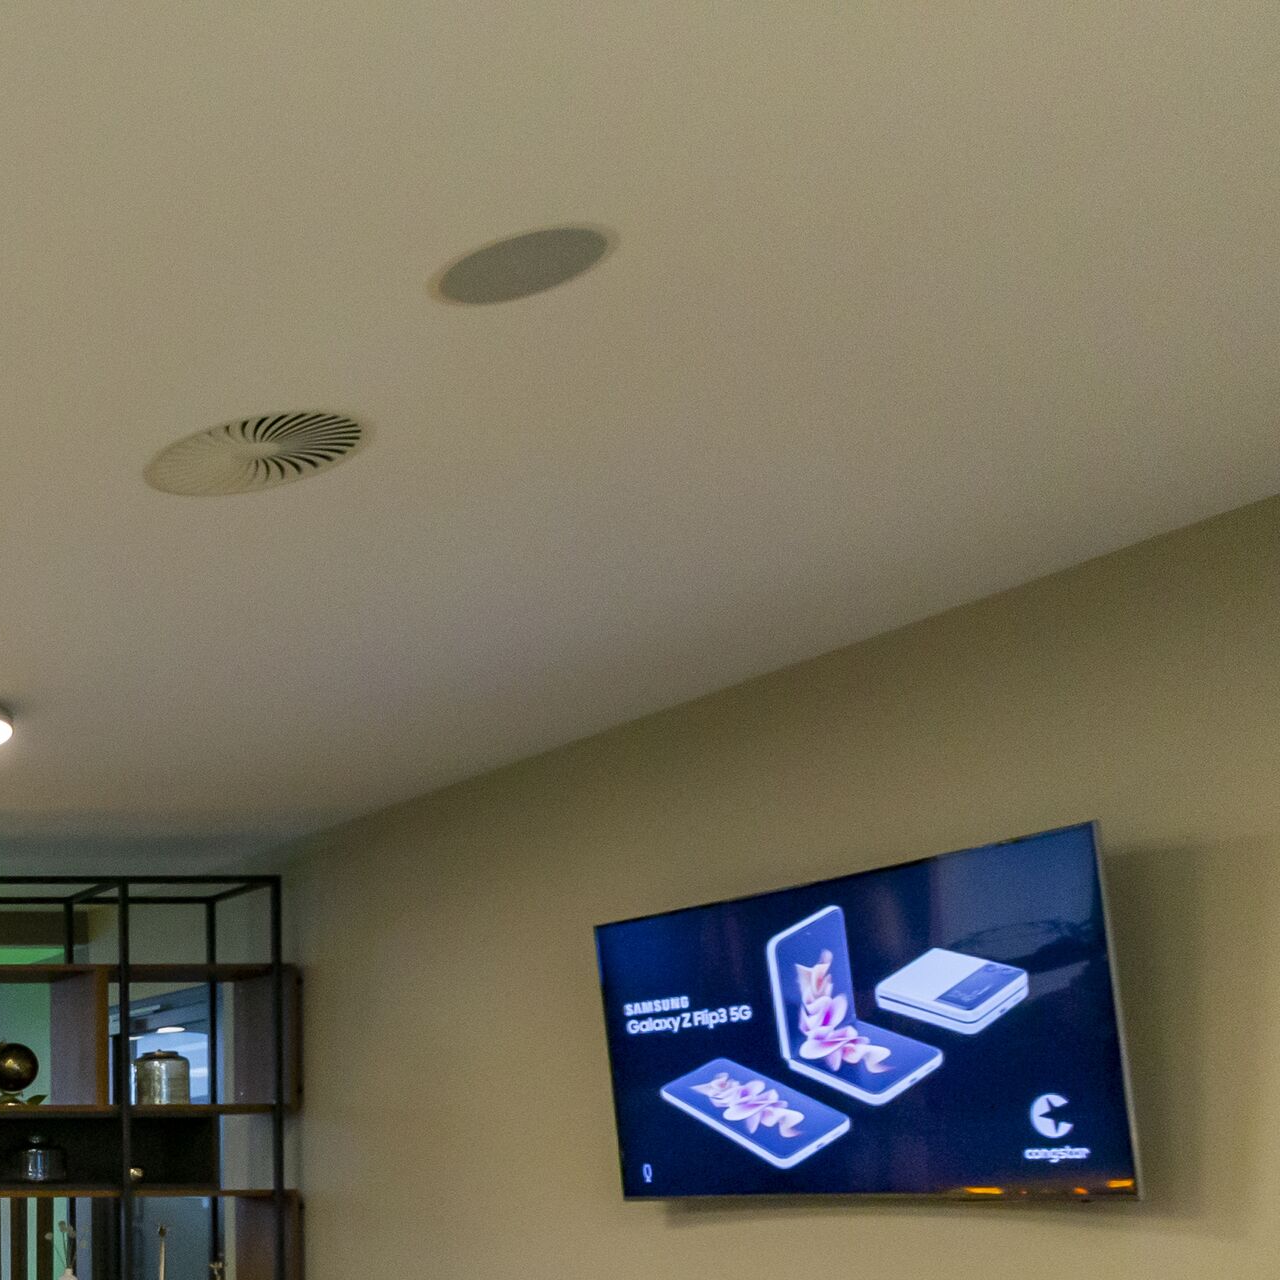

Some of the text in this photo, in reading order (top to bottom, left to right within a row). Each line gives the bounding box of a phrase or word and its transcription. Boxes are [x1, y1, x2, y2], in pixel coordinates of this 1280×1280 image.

[624, 996, 689, 1016] SAMSUNG
[626, 1005, 752, 1034] Galaxy Z Flip3 5G
